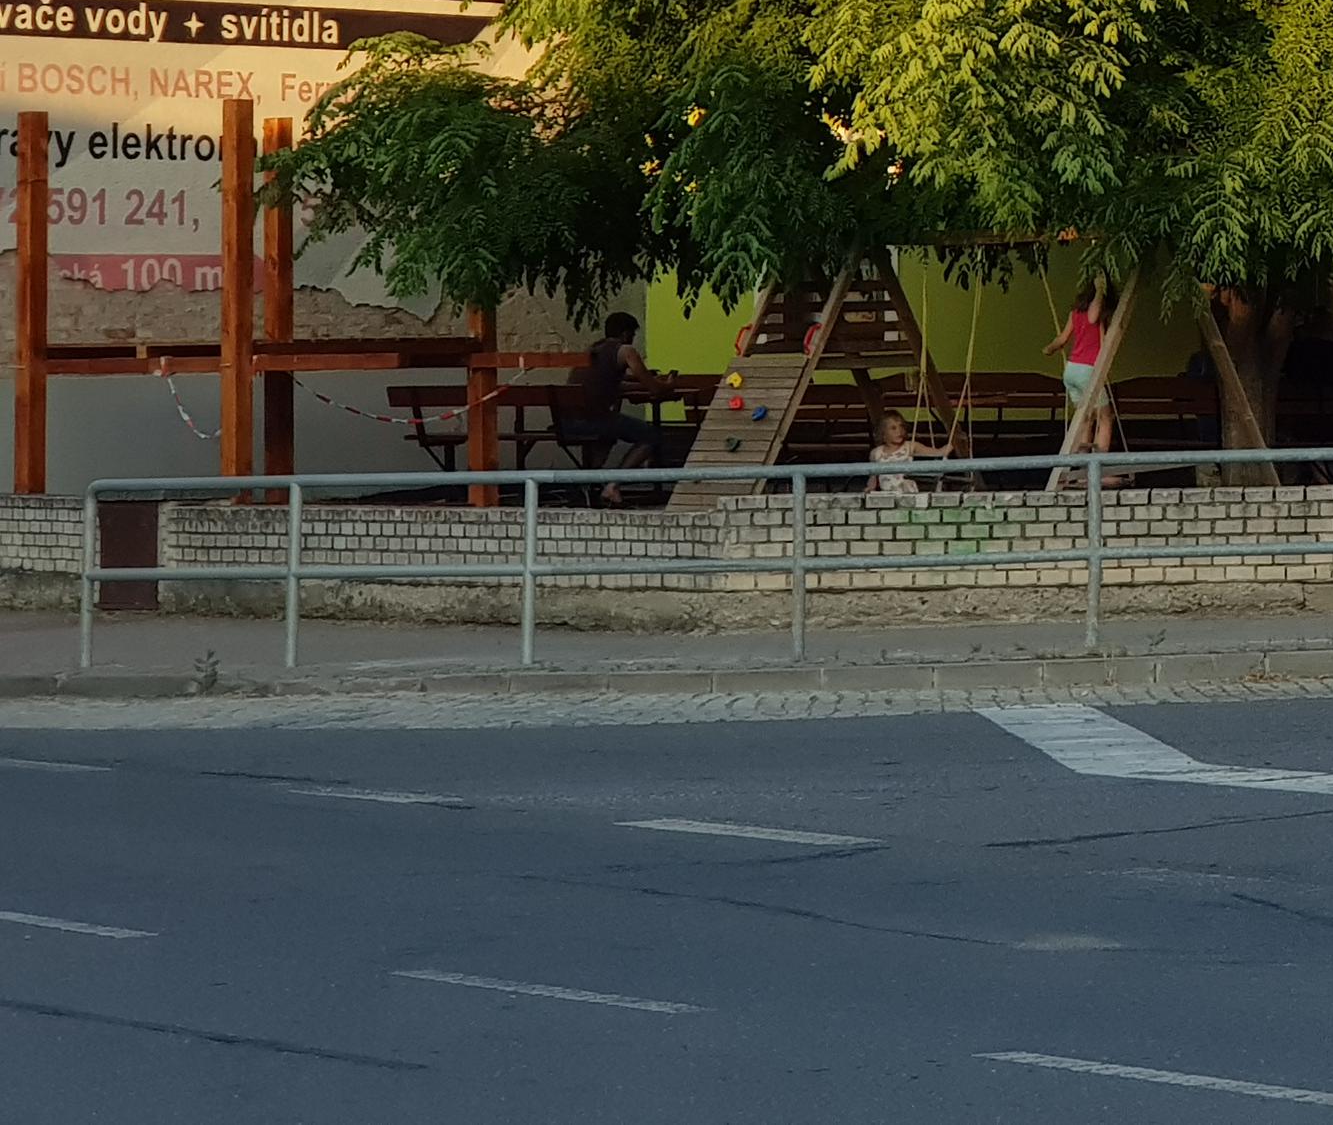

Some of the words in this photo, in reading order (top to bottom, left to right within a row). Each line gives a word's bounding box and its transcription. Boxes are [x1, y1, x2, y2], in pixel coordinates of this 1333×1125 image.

[84, 2, 169, 43] vody
[220, 8, 339, 44] svítidla
[18, 62, 139, 101] BOSCH,
[150, 67, 263, 105] NAREX,
[124, 187, 200, 232] 241,
